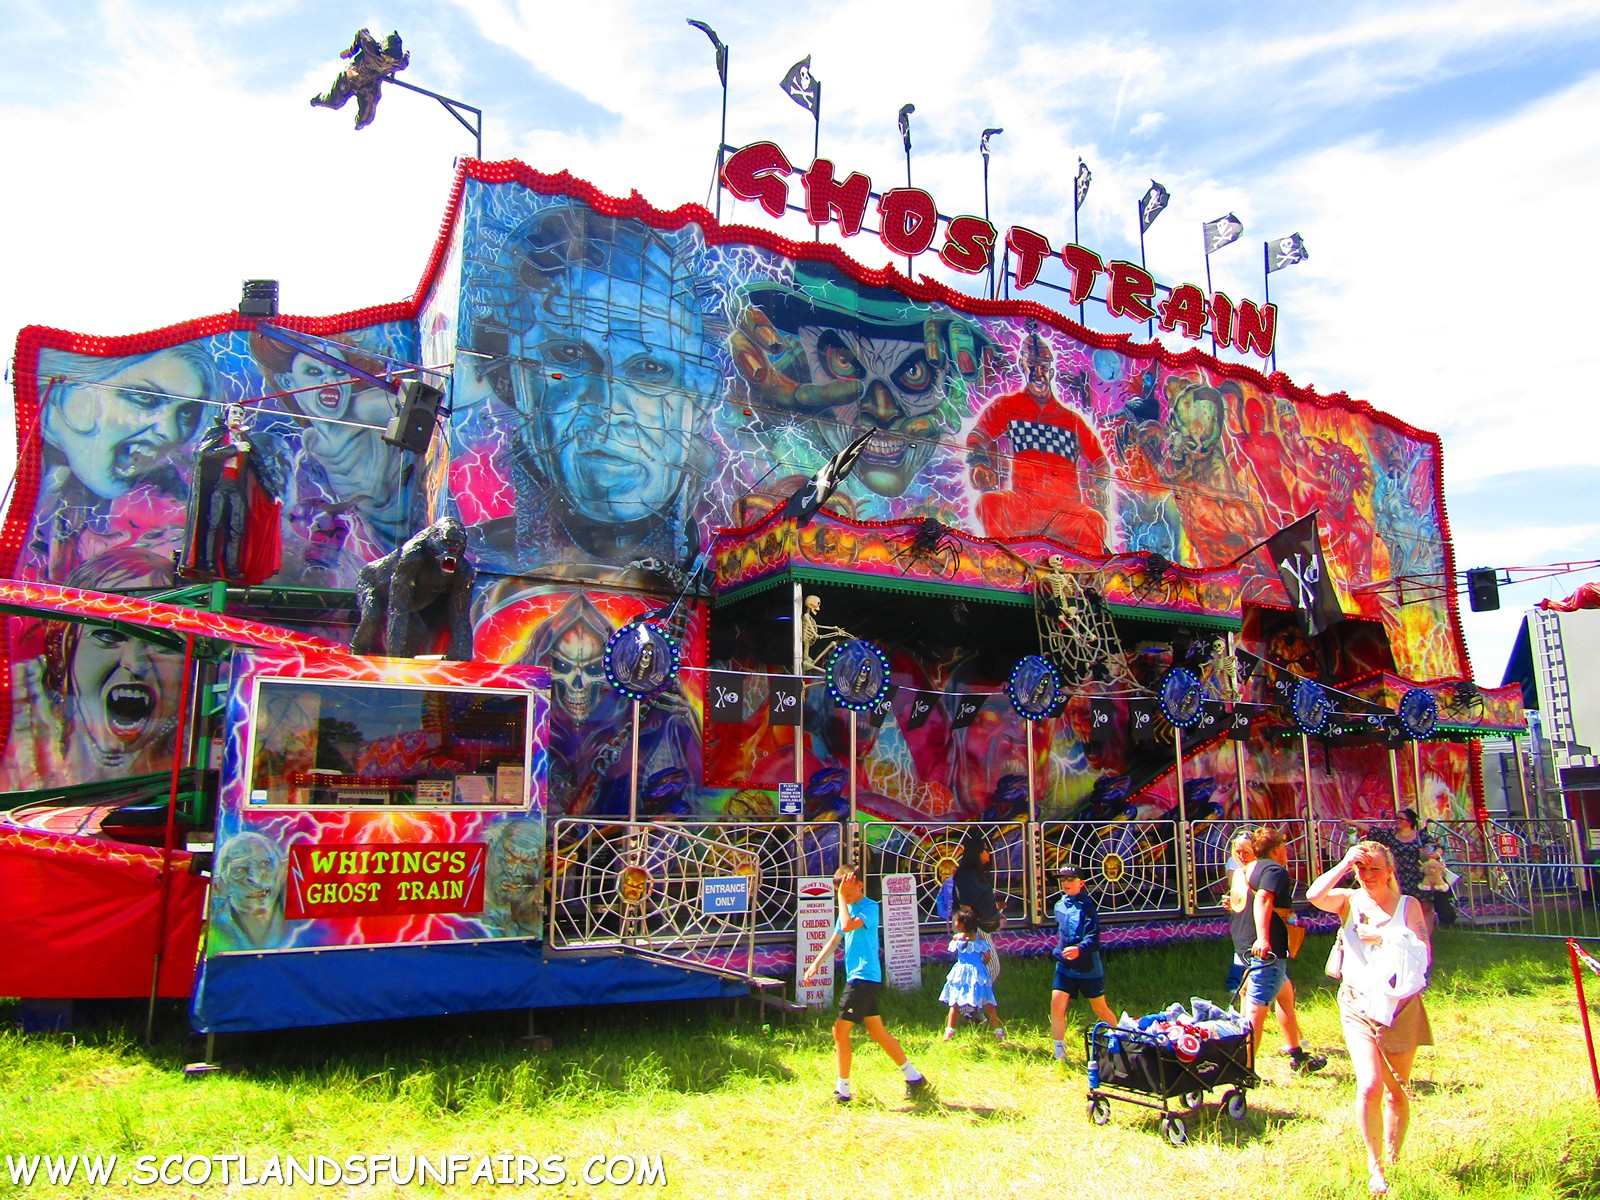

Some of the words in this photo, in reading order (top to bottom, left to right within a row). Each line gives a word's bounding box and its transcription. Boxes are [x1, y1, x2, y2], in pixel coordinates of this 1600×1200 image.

[720, 141, 1051, 290] GHOST
[1061, 243, 1278, 359] TRAIN
[310, 851, 466, 874] WHITING'S
[306, 882, 382, 904] GHOST
[397, 880, 465, 901] TRAIN
[705, 884, 746, 894] ENTRANCE
[715, 897, 736, 907] ONLY
[802, 919, 830, 928] CHILDREN
[806, 931, 826, 940] UNDER
[810, 943, 823, 952] THIS
[821, 966, 828, 974] BE
[806, 991, 814, 1000] BY
[816, 990, 824, 999] AN
